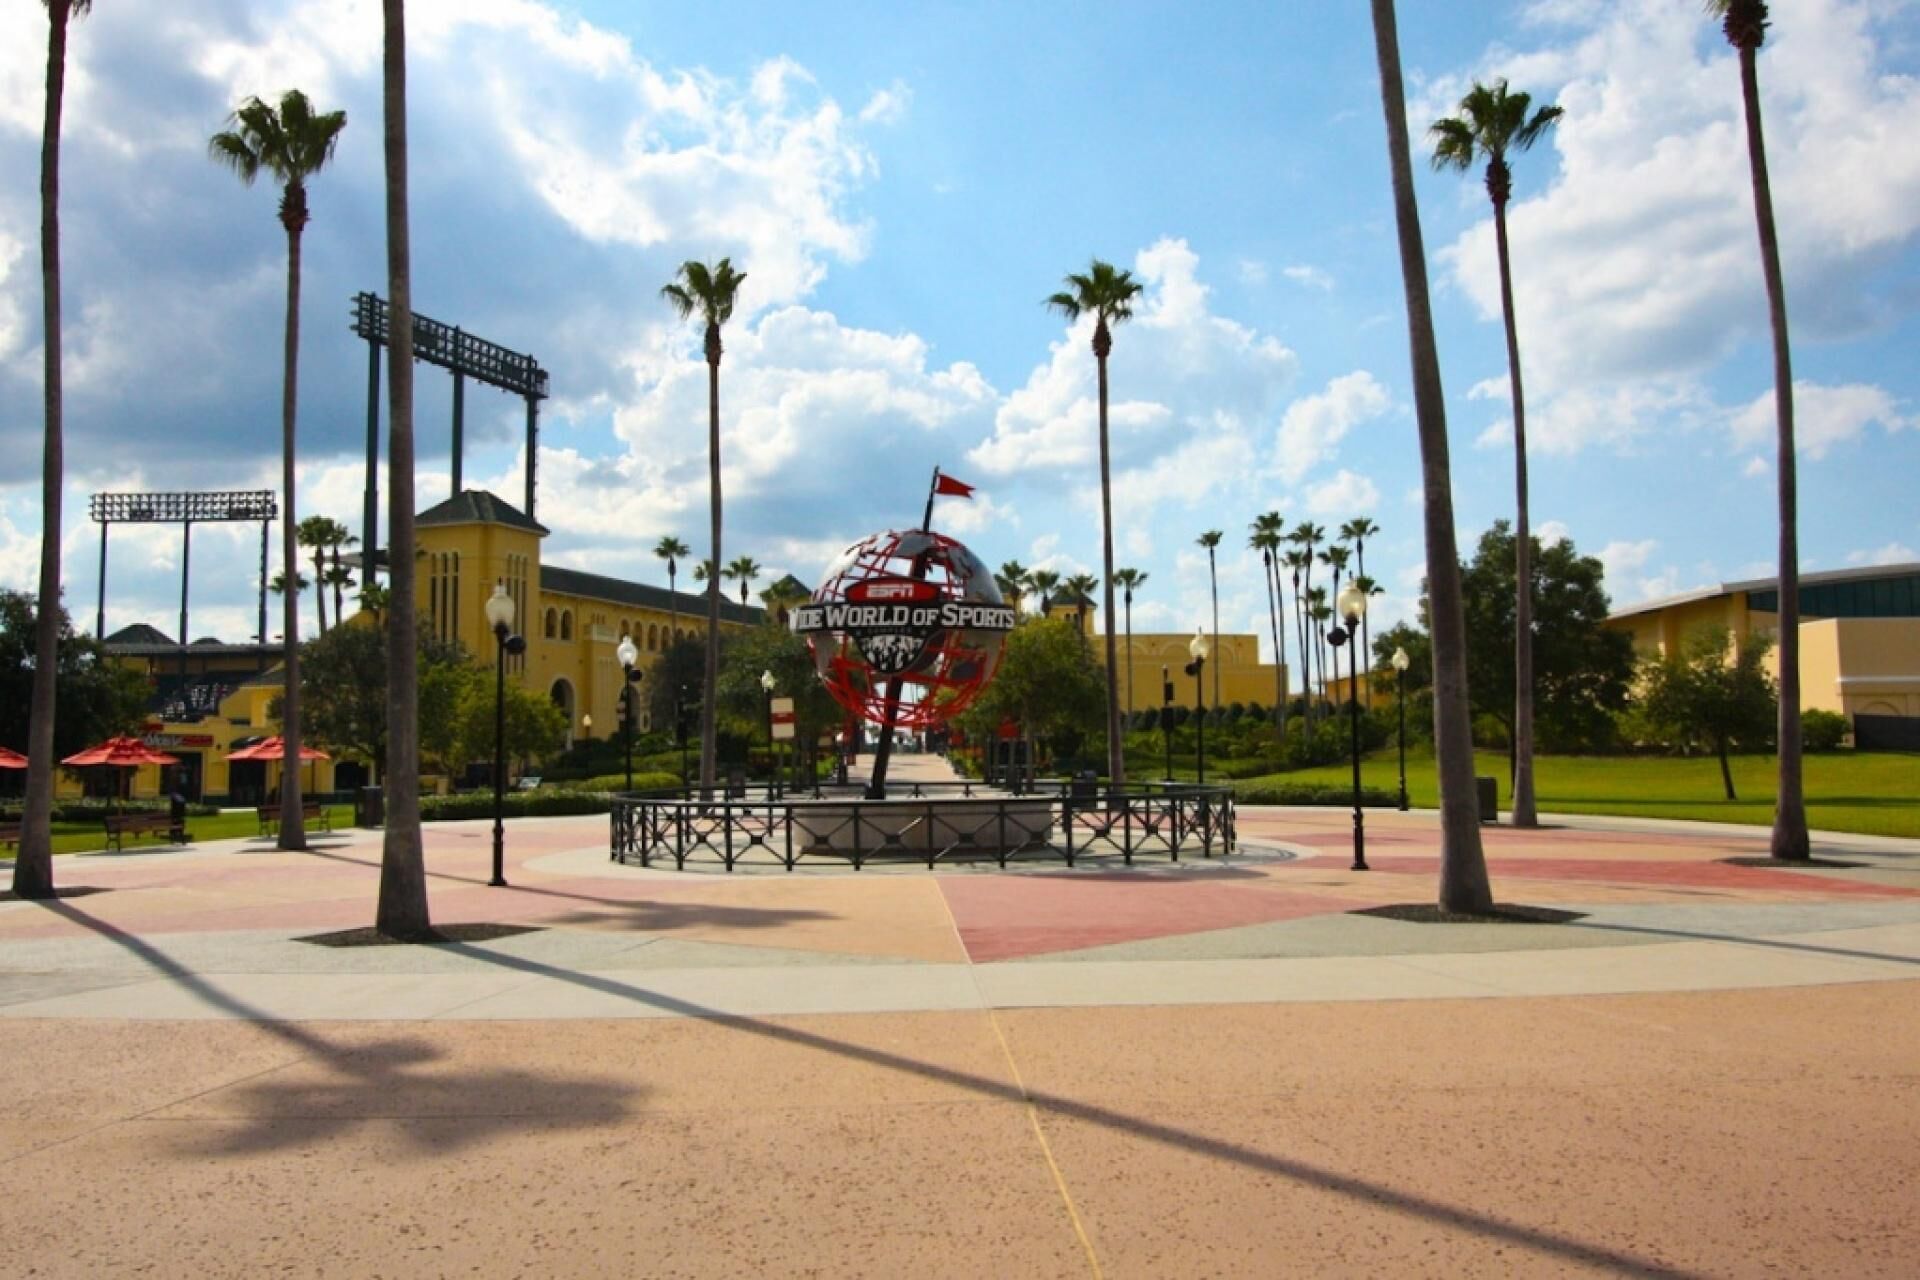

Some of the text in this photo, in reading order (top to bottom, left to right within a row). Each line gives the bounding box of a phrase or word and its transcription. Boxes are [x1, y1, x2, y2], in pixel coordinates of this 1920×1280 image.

[866, 584, 913, 597] ESPN
[824, 604, 909, 627] WORLD
[912, 607, 938, 626] OF
[941, 603, 1014, 629] SPORTS
